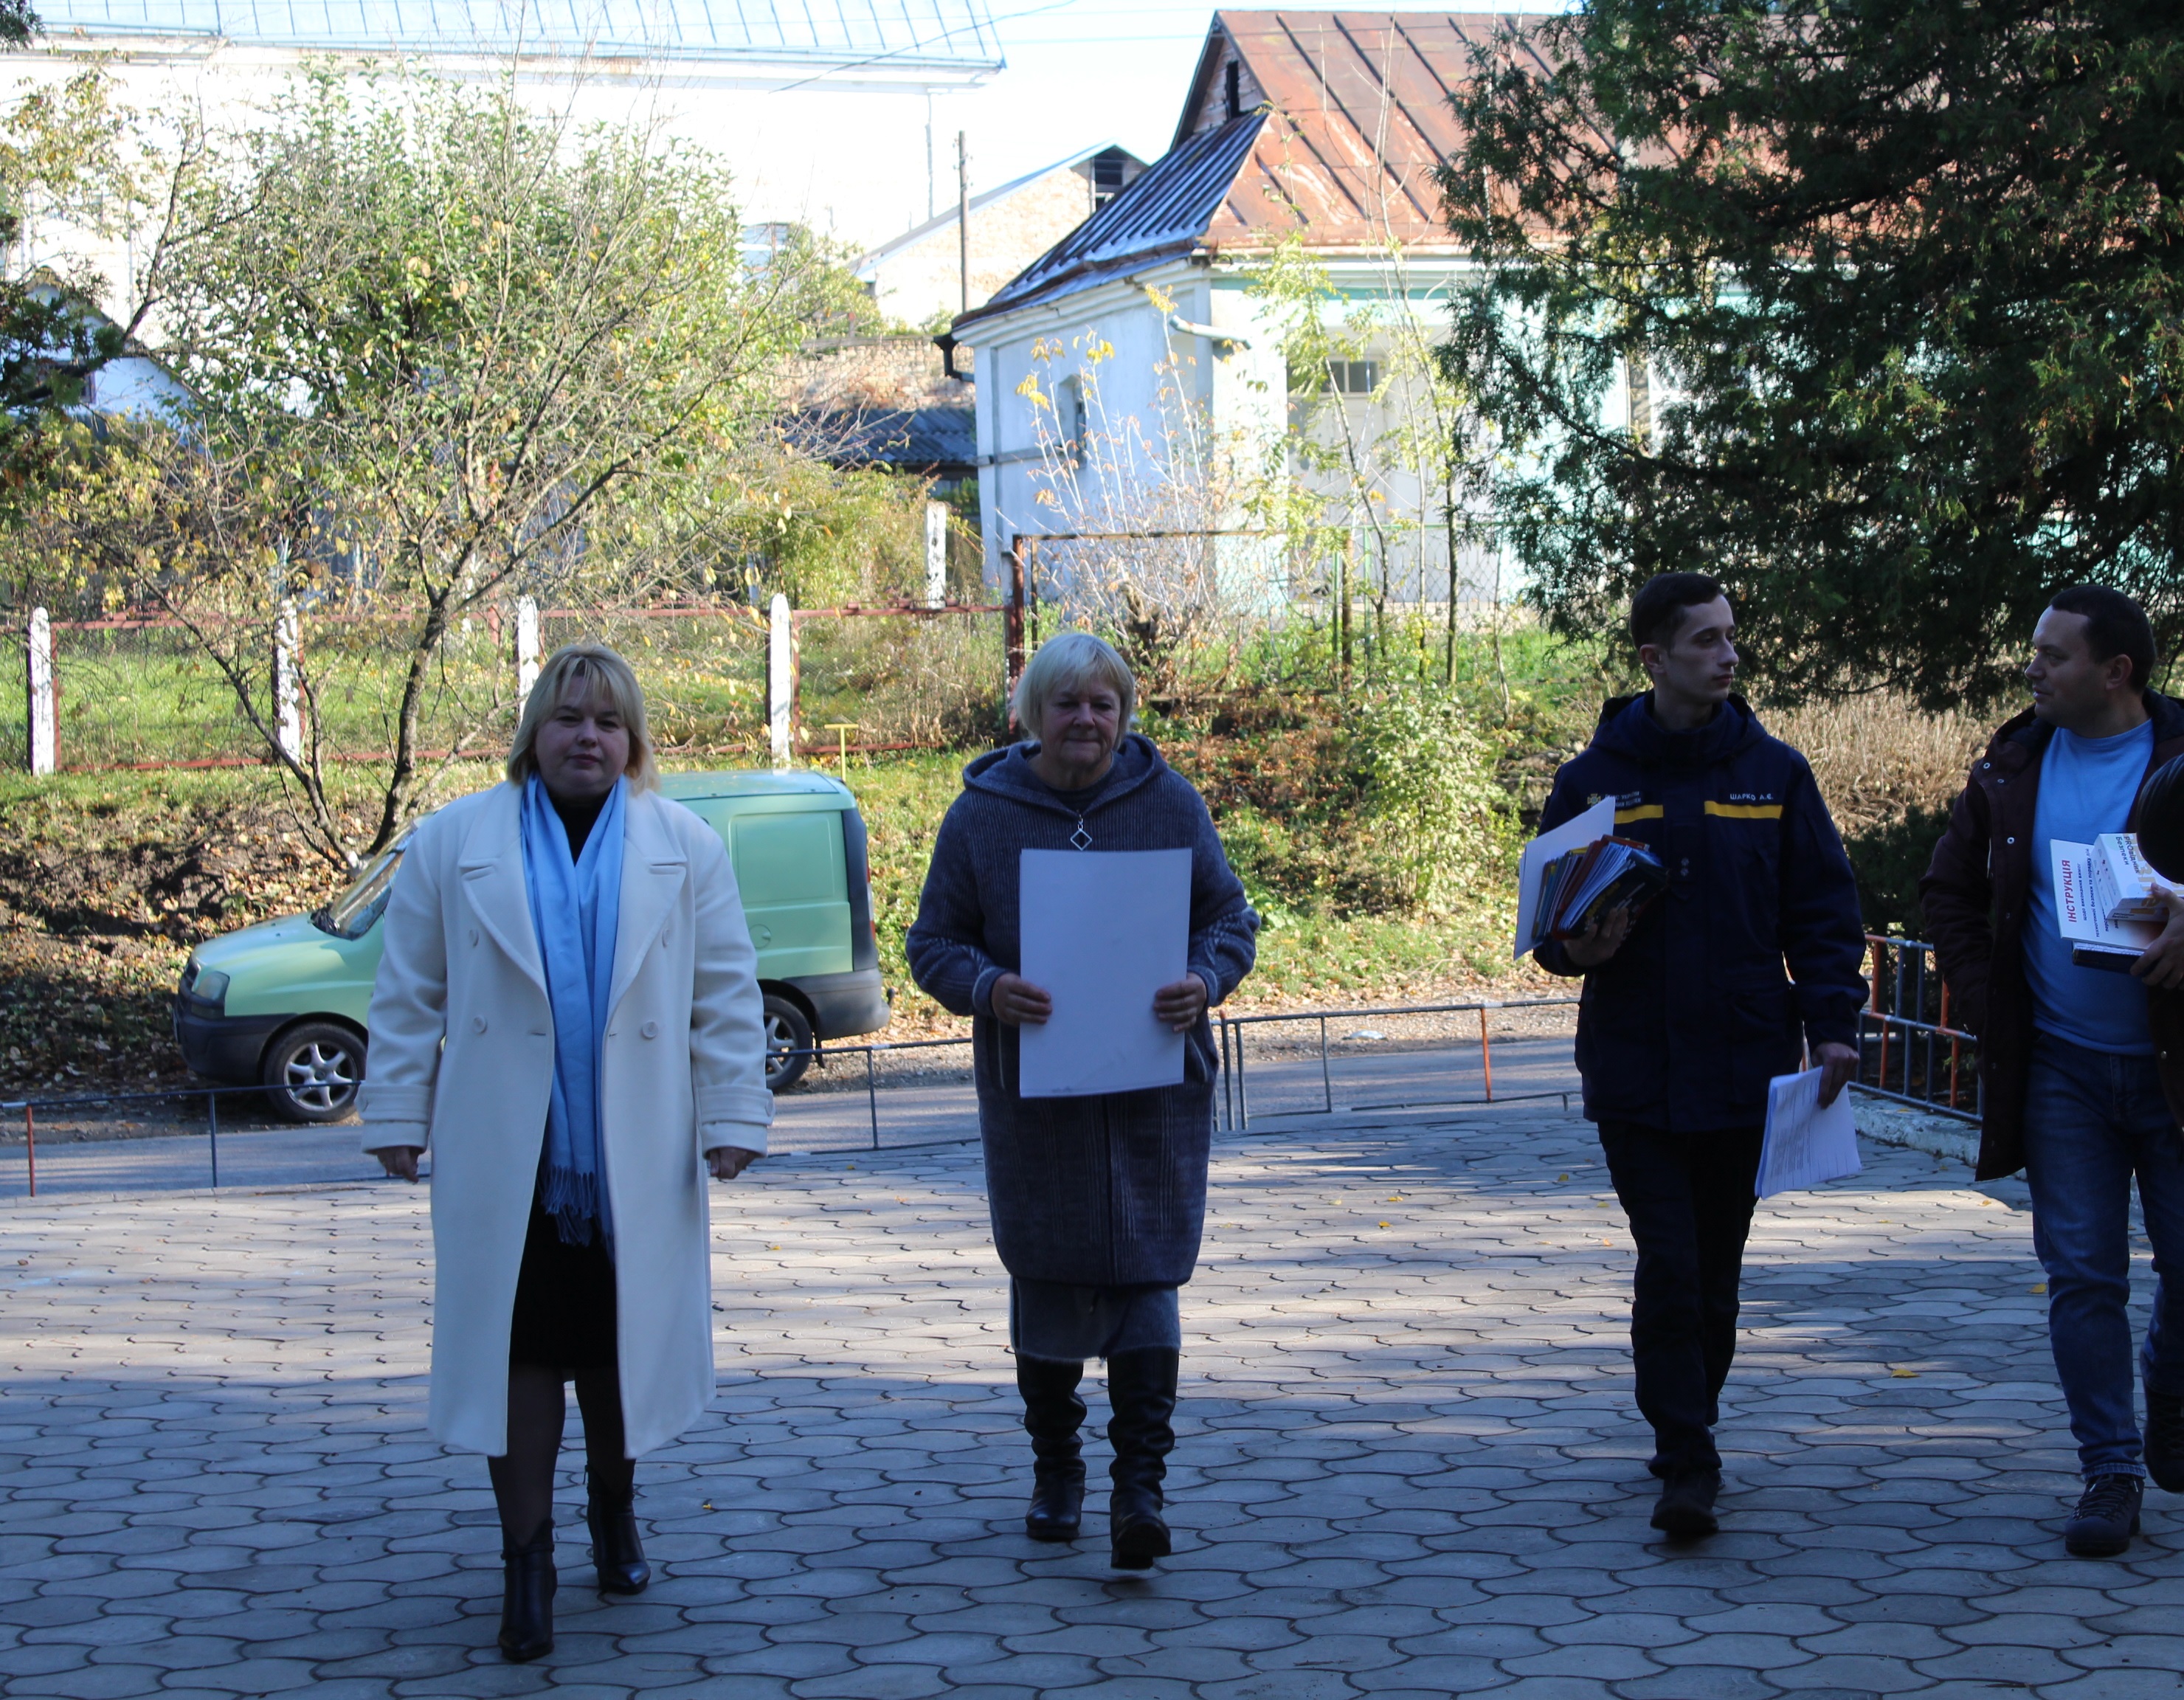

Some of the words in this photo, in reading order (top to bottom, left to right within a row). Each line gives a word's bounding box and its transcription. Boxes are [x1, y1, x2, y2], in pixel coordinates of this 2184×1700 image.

[1729, 793, 1756, 801] ШАРКО
[2115, 836, 2129, 865] Безпеки
[2062, 860, 2077, 922] ІНСТРУКЦІЯ
